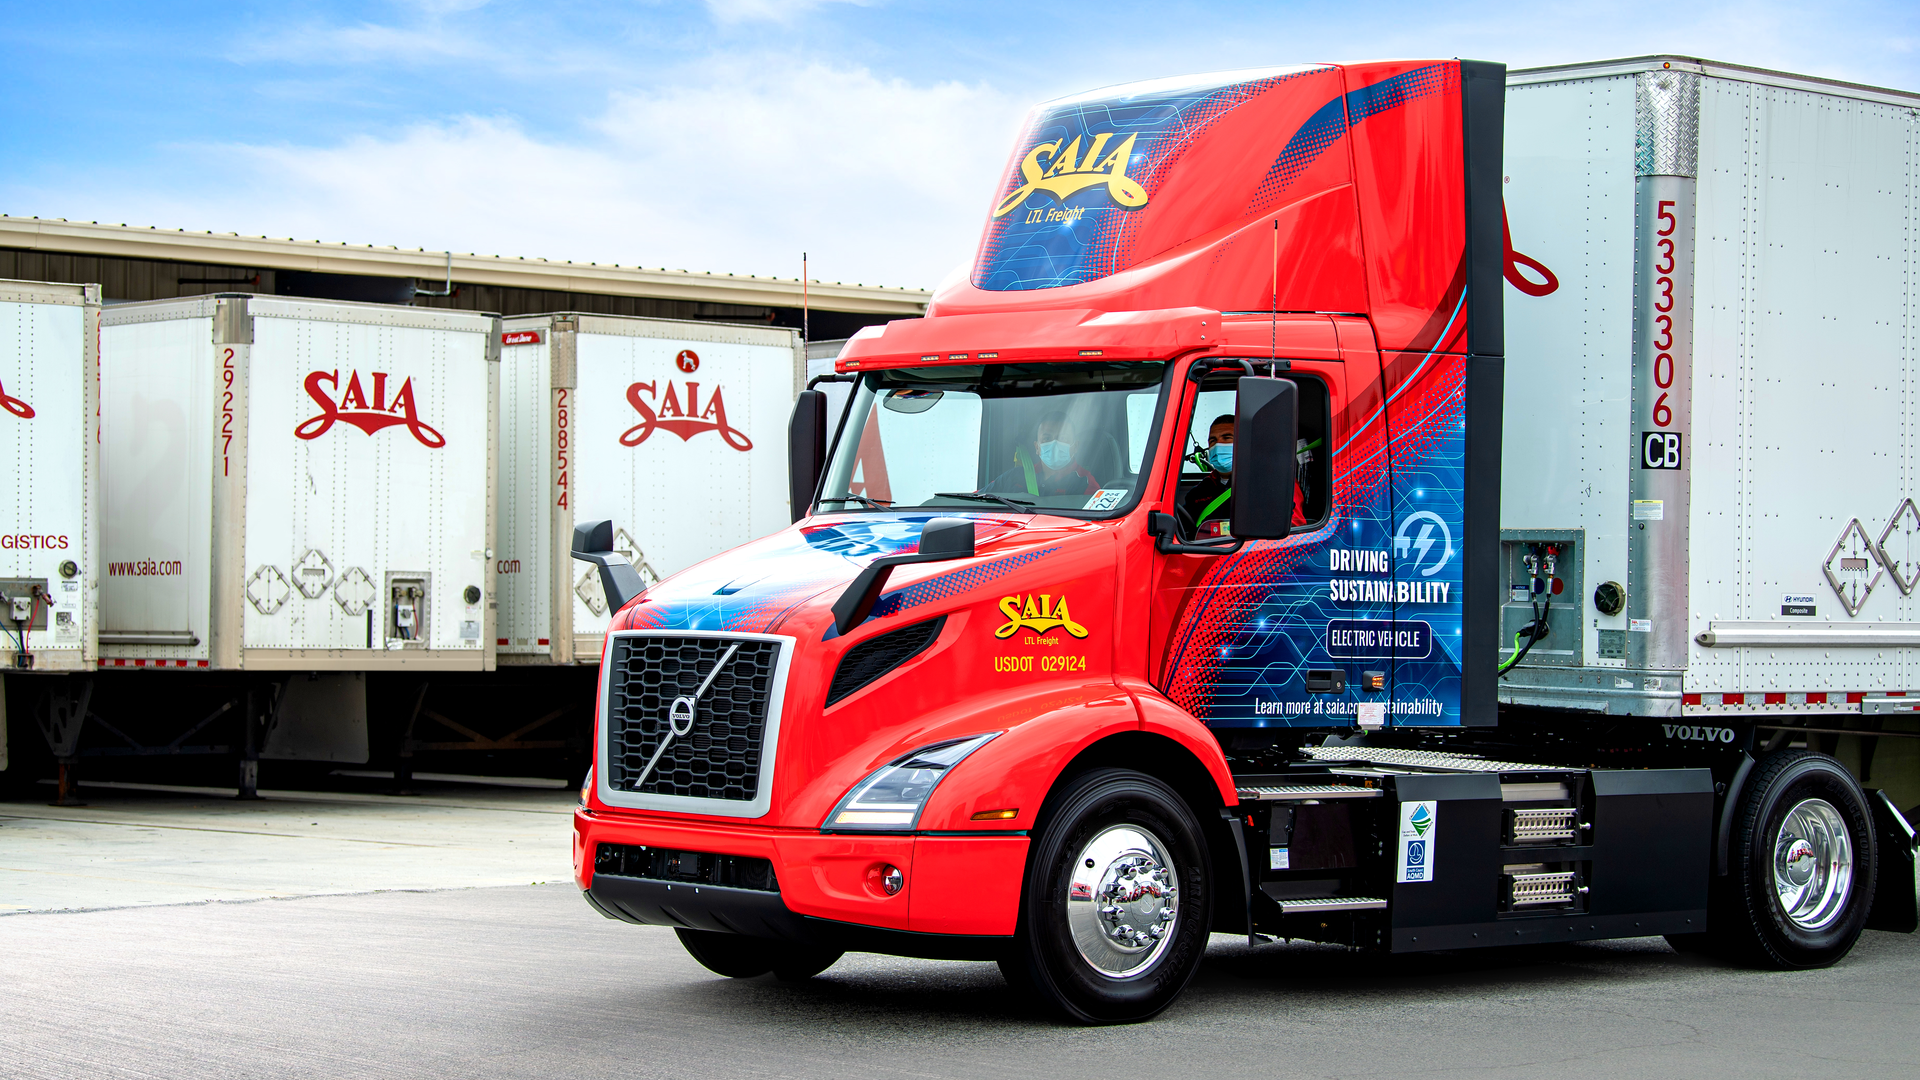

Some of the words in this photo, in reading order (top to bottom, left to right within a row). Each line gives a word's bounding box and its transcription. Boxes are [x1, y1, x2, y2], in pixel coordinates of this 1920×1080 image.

[992, 132, 1149, 218] SAIA
[1025, 209, 1043, 224] LTL
[1045, 205, 1086, 224] Freight
[1652, 200, 1676, 428] 533306
[222, 348, 235, 477] 292271
[294, 368, 446, 449] SAIA
[618, 379, 754, 452] SAIA
[556, 388, 569, 511] 288544
[1645, 433, 1679, 468] CB
[1, 535, 69, 549] GISTICS
[108, 557, 182, 576] www.saia.com
[497, 559, 521, 575] com
[1330, 548, 1389, 573] DRIVING
[1329, 579, 1450, 604] SUSTAINABILITY
[994, 593, 1089, 640] SAIA
[1024, 636, 1035, 645] LTL
[1037, 636, 1059, 647] Freight
[1332, 629, 1376, 647] ELECTRIC
[1377, 630, 1420, 647] VEHICLE
[994, 655, 1034, 672] USDOT
[1041, 655, 1086, 672] 029124
[1255, 697, 1283, 715] Learn
[1286, 702, 1311, 715] more
[1313, 700, 1324, 715] at
[1661, 723, 1736, 744] VOLVO
